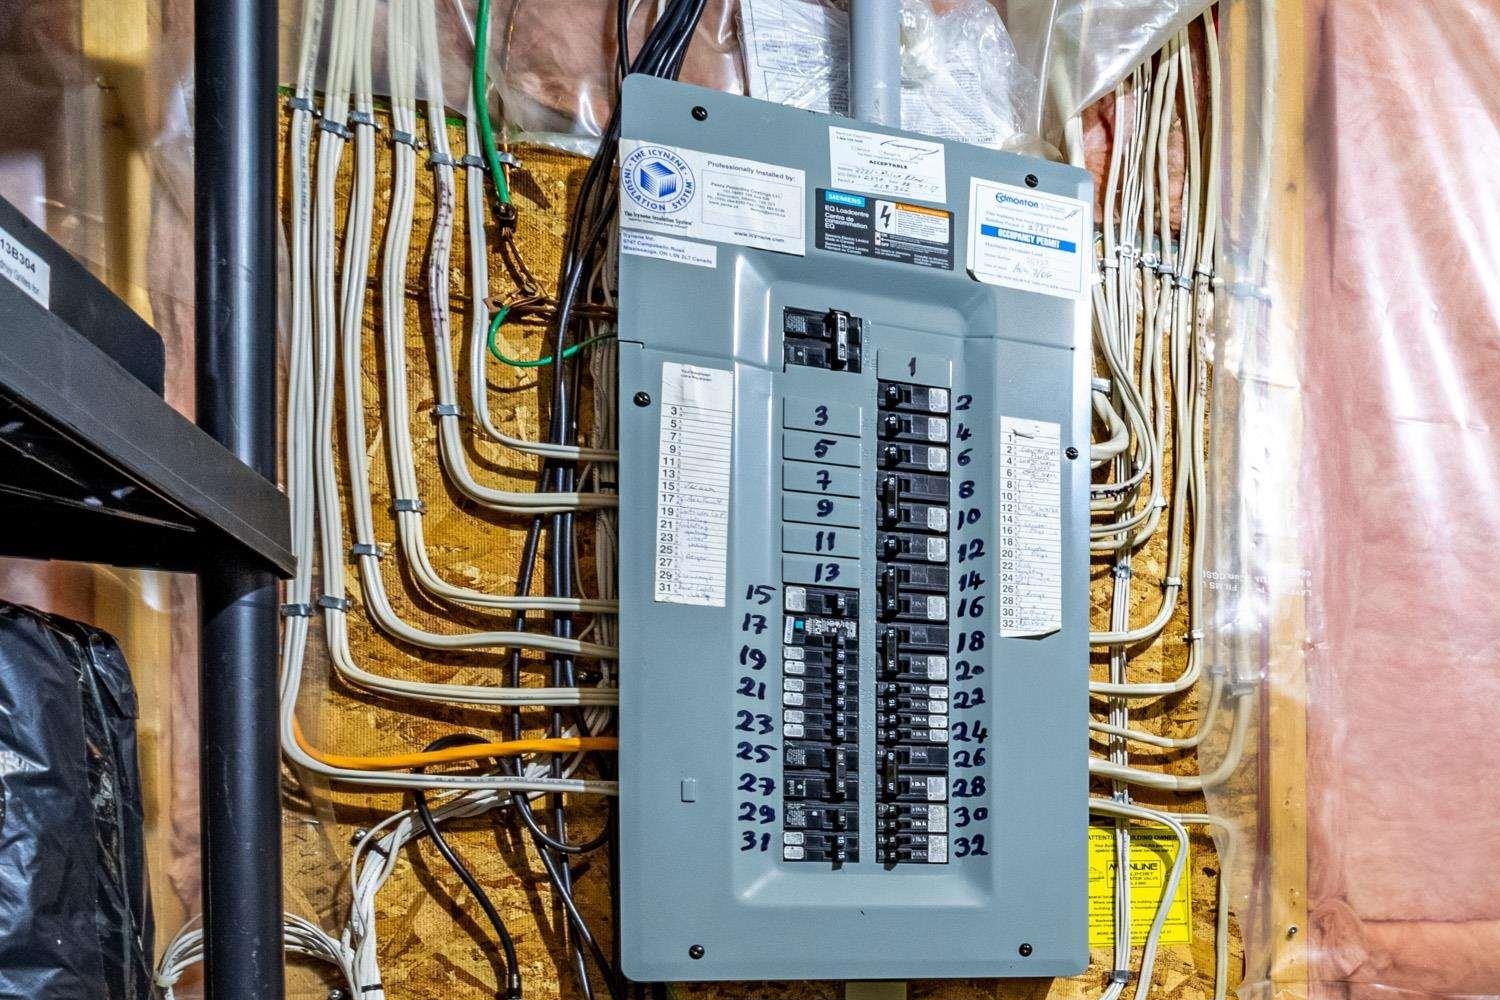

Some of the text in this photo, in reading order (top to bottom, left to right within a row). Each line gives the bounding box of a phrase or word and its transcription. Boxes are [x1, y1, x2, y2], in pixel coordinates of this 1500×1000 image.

[631, 149, 687, 172] THE ICYNENE
[707, 160, 754, 175] Professionally
[756, 167, 784, 180] Installed
[622, 171, 666, 212] INSULATION
[672, 181, 693, 209] SYSTEM
[996, 192, 1038, 208] Edmonton
[908, 357, 916, 376] 1
[671, 407, 677, 415] 3
[956, 394, 973, 411] 2
[671, 420, 676, 428] 5
[814, 405, 829, 427] 3
[670, 432, 676, 440] 7
[955, 422, 973, 442] 4
[1008, 434, 1012, 442] 1
[670, 445, 676, 454] 9
[813, 438, 838, 459] 5
[957, 447, 974, 467] 6
[1007, 446, 1012, 454] 2
[663, 457, 674, 466] 11
[663, 469, 675, 478] 13
[816, 469, 833, 491] 7
[663, 481, 675, 490] 15
[958, 479, 976, 500] 8
[662, 494, 674, 502] 17
[1002, 492, 1012, 500] 10
[662, 507, 674, 516] 19
[816, 498, 834, 518] 9
[956, 507, 982, 529] 10
[1002, 504, 1012, 512] 12
[660, 520, 672, 529] 21
[1002, 526, 1013, 534] 16
[660, 533, 673, 542] 23
[815, 530, 836, 552] 11
[1003, 538, 1013, 546] 18
[660, 545, 673, 554] 25
[957, 537, 986, 564] 12
[1002, 550, 1013, 558] 20
[660, 558, 672, 566] 27
[814, 562, 841, 582] 13
[1002, 562, 1013, 570] 22
[660, 571, 672, 580] 29
[958, 570, 986, 593] 14
[1002, 574, 1013, 582] 24
[659, 583, 672, 591] 31
[745, 584, 777, 606] 15
[1002, 585, 1014, 593] 26
[956, 595, 986, 619] 16
[1002, 608, 1014, 616] 30
[742, 612, 768, 635] 17
[956, 630, 986, 654] 18
[739, 644, 767, 671] 19
[955, 660, 985, 682] 20
[736, 676, 767, 701] 21
[953, 686, 987, 710] 22
[735, 709, 775, 736] 23
[951, 719, 989, 745] 24
[735, 741, 778, 764] 25
[952, 747, 986, 768] 26
[737, 772, 777, 797] 27
[951, 775, 987, 799] 28
[737, 801, 776, 825] 29
[953, 806, 989, 828] 30
[740, 830, 772, 853] 31
[953, 833, 990, 859] 32
